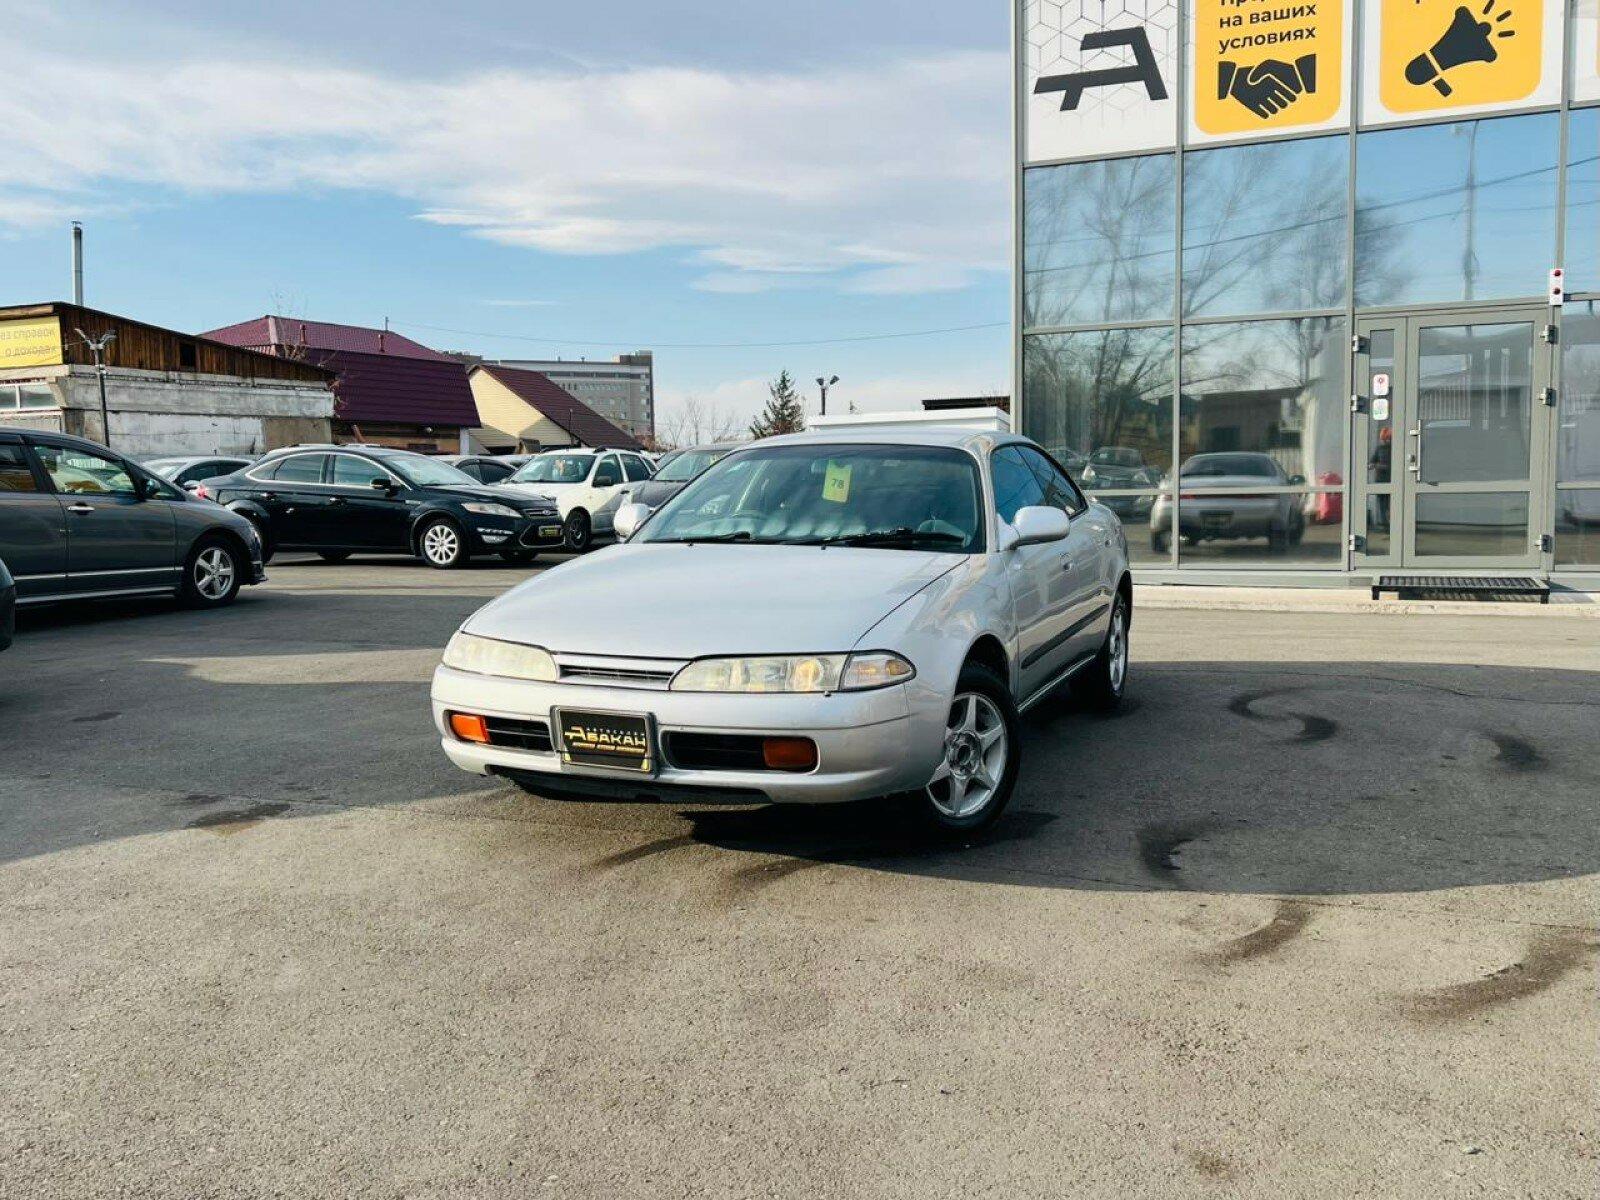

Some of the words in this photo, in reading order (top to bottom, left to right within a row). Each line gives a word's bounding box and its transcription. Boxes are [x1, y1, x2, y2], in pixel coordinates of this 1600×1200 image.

[1219, 14, 1243, 28] на
[1249, 4, 1317, 24] ваших
[1219, 26, 1316, 55] условиях
[564, 725, 646, 746] АБАКАН
